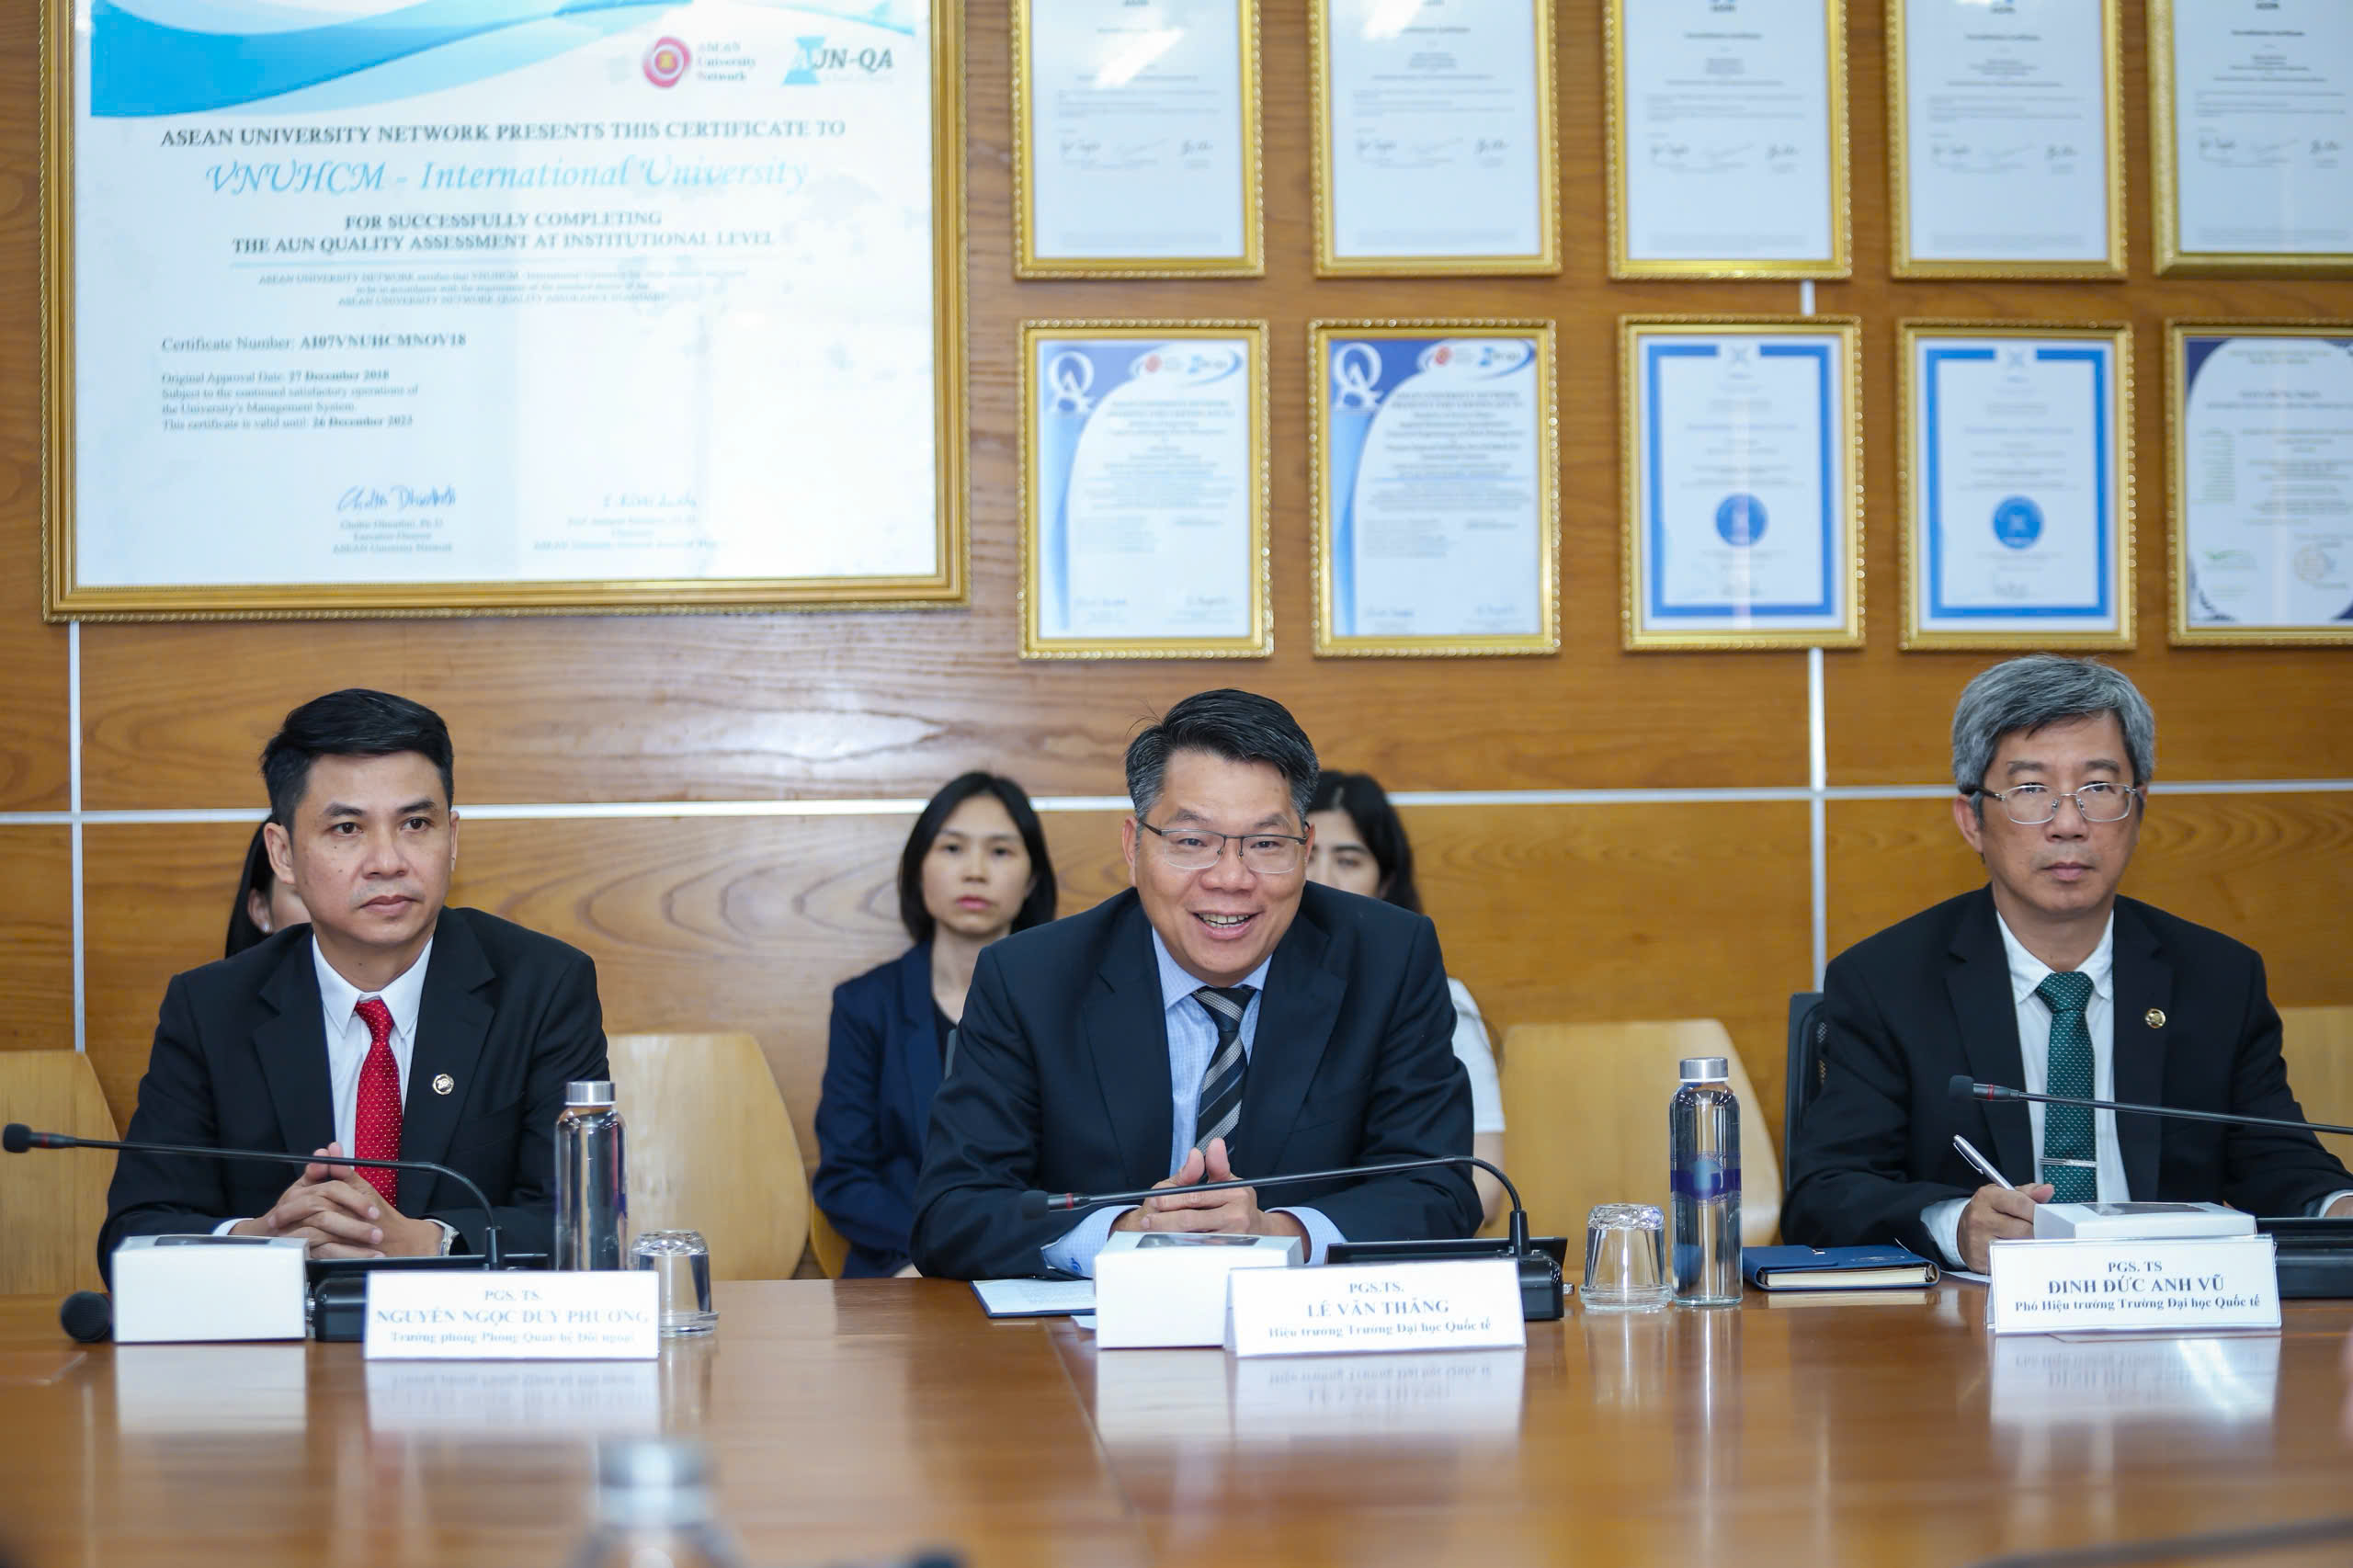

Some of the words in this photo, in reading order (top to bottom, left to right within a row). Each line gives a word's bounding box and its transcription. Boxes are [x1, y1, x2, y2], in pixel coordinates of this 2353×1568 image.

[161, 128, 234, 147] ASEAN
[240, 125, 372, 146] UNIVERSITY
[378, 123, 489, 143] NETWORK
[496, 121, 605, 142] PRESENTS
[610, 120, 661, 138] THIS
[665, 119, 810, 138] CERTIFICATE
[816, 119, 847, 137] TO
[205, 159, 387, 196] VNUHCM
[420, 154, 637, 190] International
[642, 153, 807, 194] University
[345, 213, 382, 231] FOR
[388, 211, 530, 230] SUCCESSFULLY
[535, 210, 663, 227] COMPLETING
[232, 237, 270, 254] THE
[276, 236, 315, 253] AUN
[322, 235, 404, 255] QUALITY
[411, 233, 529, 251] ASSESSMENT
[536, 233, 561, 249] AT
[565, 232, 707, 248] INSTITUTIONAL
[717, 230, 774, 246] LEVEL
[161, 335, 230, 352] Certificate
[162, 370, 203, 386] Original
[208, 370, 255, 386] Approval
[305, 369, 359, 382] December
[328, 415, 382, 428] December
[2109, 1261, 2140, 1273] PGS.
[2143, 1260, 2163, 1272] TS
[1349, 1281, 1404, 1294] PGS.TS.
[2048, 1279, 2097, 1293] ĐINH
[2103, 1275, 2147, 1292] ĐỨC
[2151, 1278, 2191, 1292] ANH
[2198, 1274, 2224, 1291] VŨ
[2016, 1300, 2038, 1312] Phó
[2042, 1299, 2070, 1312] Hiệu
[2167, 1297, 2188, 1310] Đại
[2191, 1296, 2211, 1310] học
[2215, 1294, 2246, 1308] Quốc
[2249, 1293, 2261, 1308] tế
[1421, 1321, 1442, 1334] học
